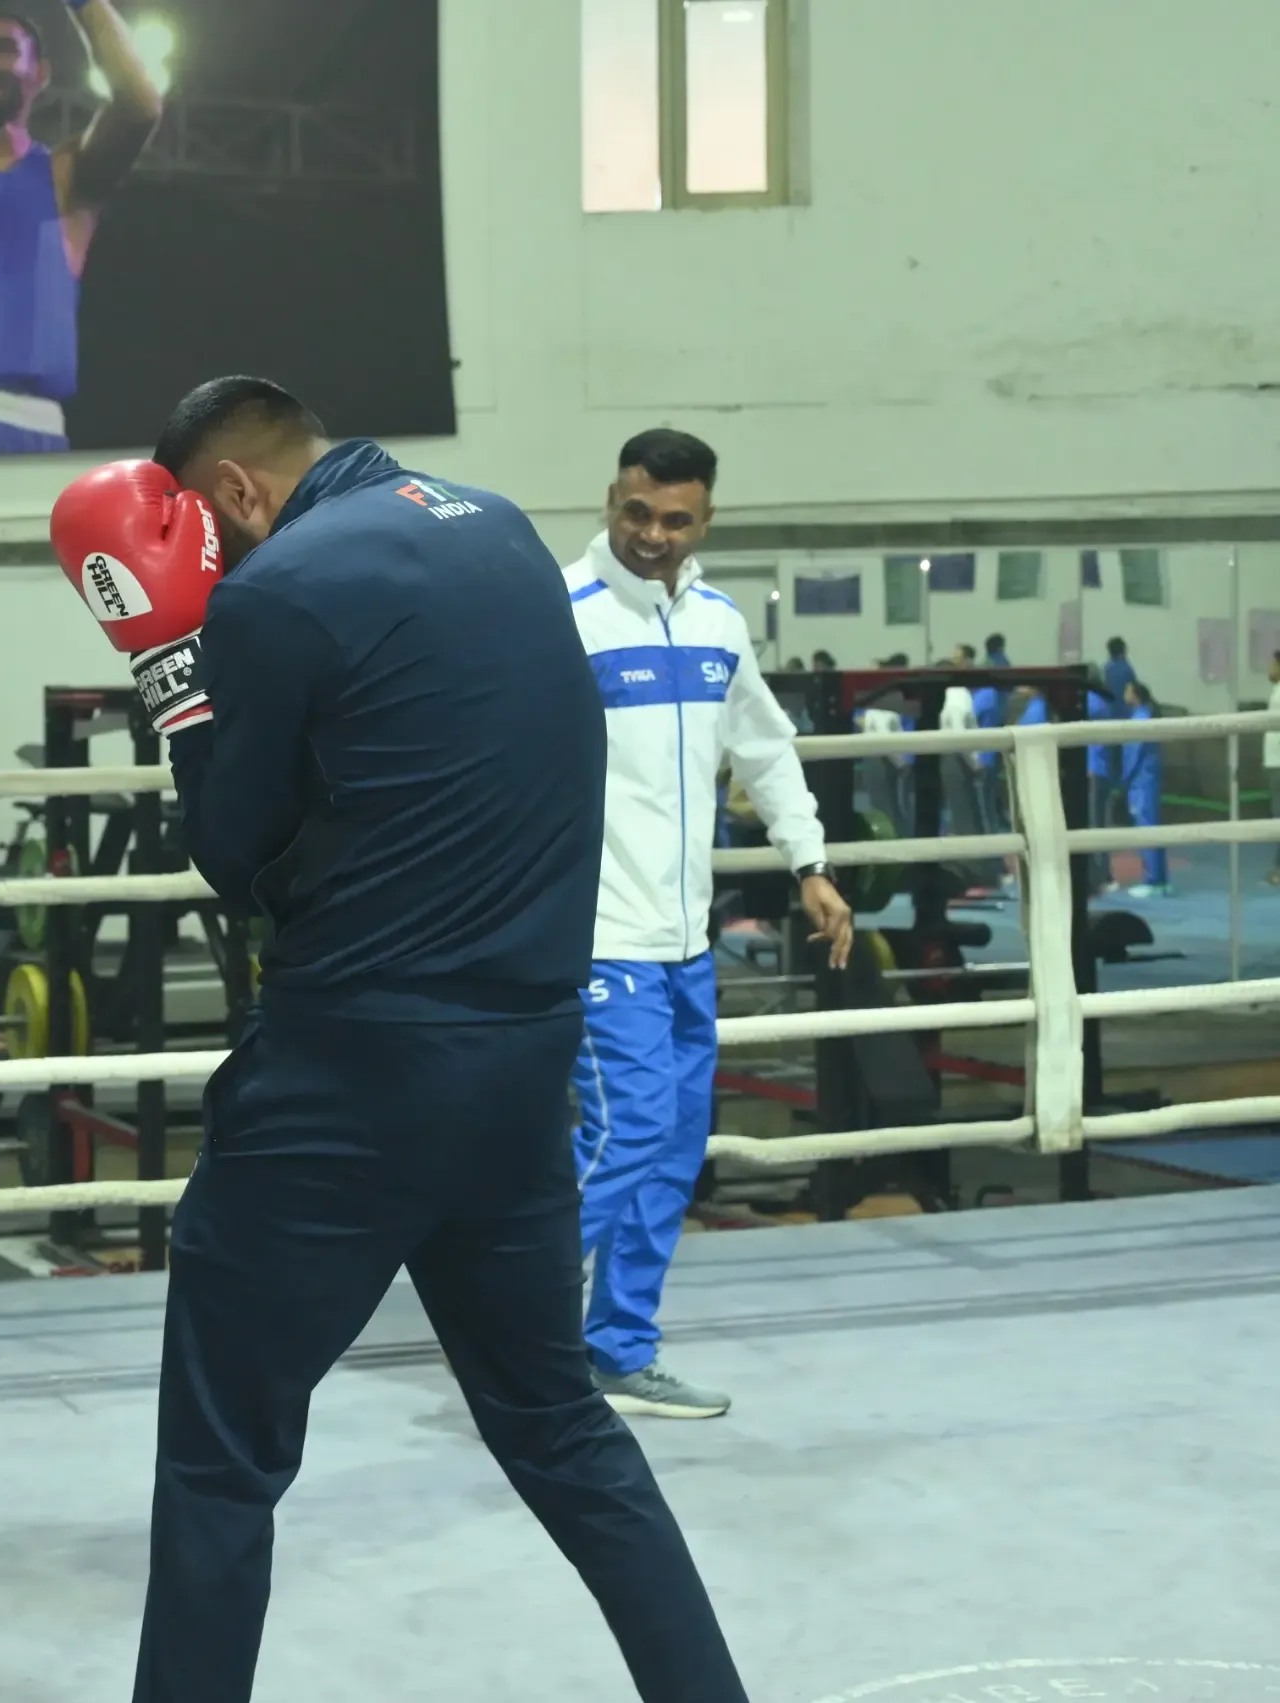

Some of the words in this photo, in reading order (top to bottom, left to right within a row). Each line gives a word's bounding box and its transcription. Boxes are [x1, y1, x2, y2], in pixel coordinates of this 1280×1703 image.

[195, 499, 220, 572] Tiger
[427, 500, 483, 520] INDIA
[86, 562, 112, 614] HILL
[95, 555, 130, 617] GREEN
[141, 673, 189, 713] HILL
